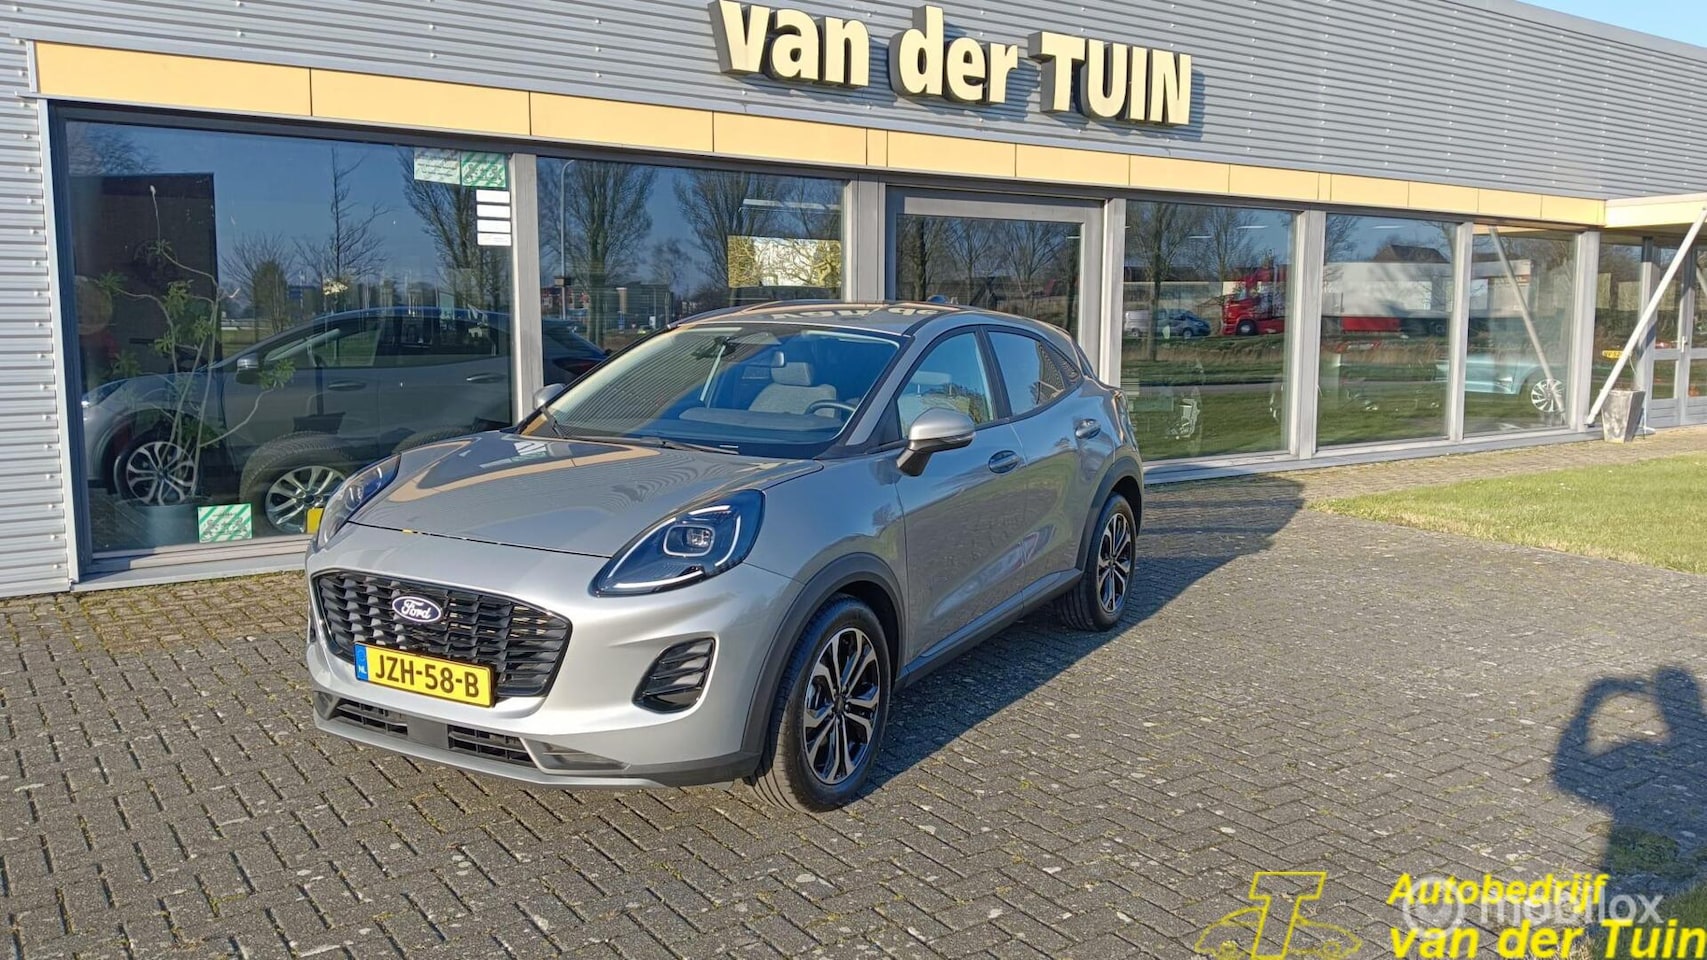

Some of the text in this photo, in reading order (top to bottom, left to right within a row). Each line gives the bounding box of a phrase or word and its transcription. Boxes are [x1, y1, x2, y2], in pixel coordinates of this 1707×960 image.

[717, 0, 1193, 126] van der TUIN
[400, 598, 432, 620] Ford
[374, 654, 480, 699] JZH-58-B
